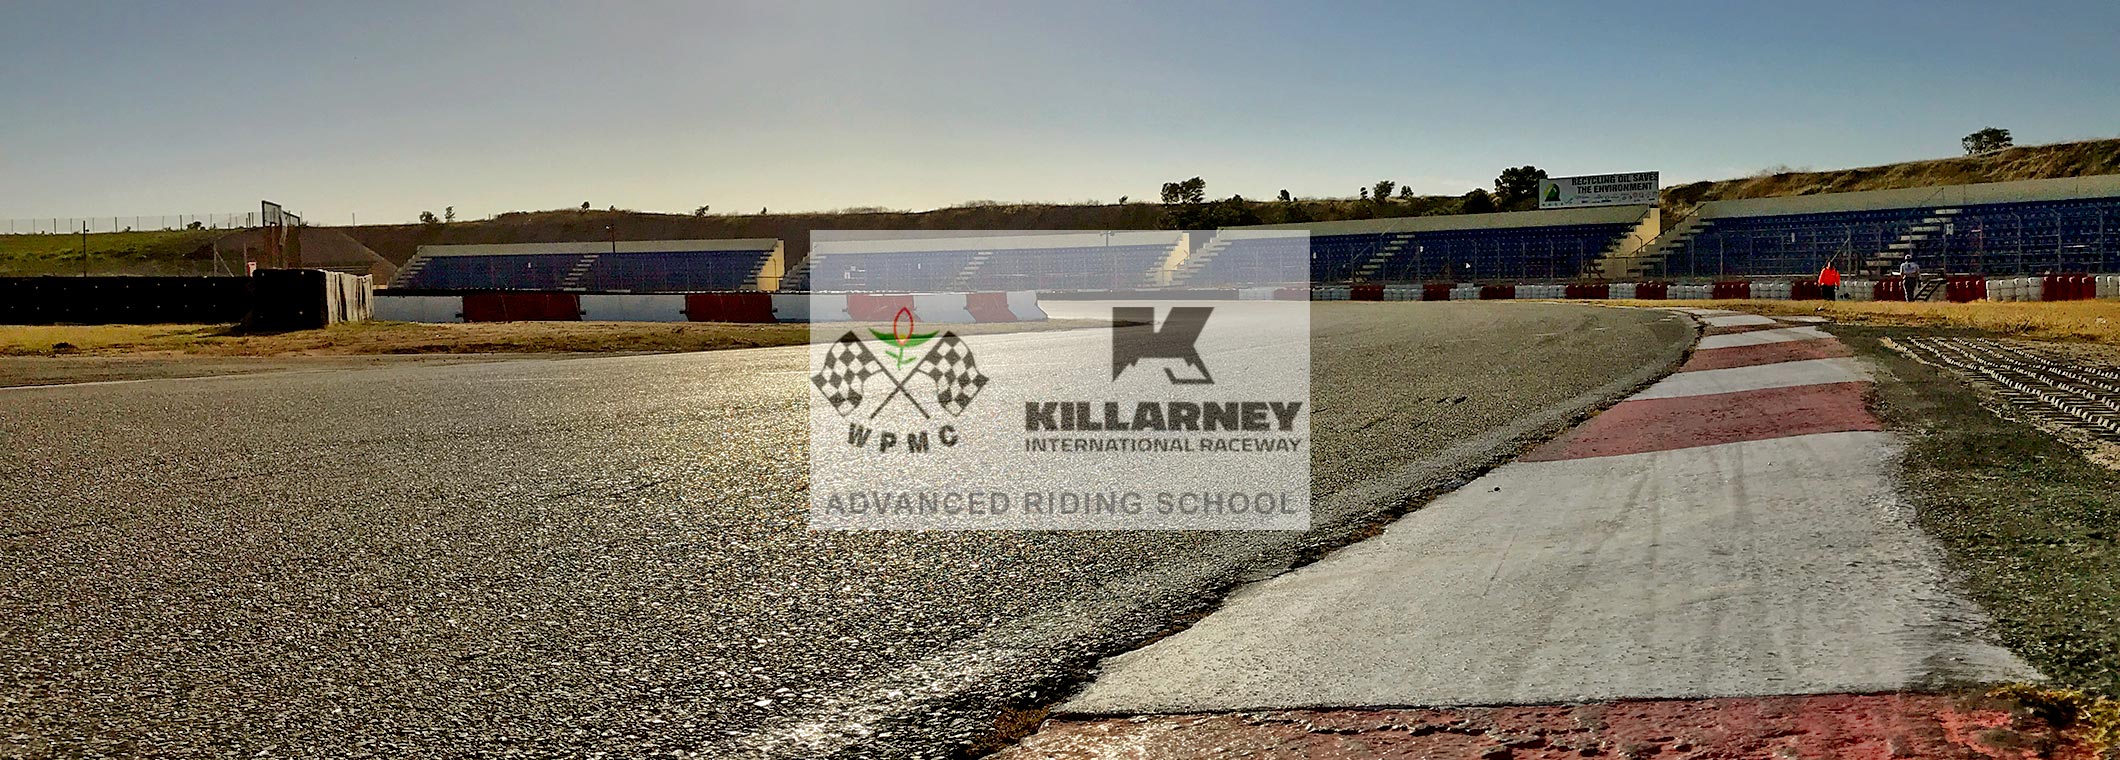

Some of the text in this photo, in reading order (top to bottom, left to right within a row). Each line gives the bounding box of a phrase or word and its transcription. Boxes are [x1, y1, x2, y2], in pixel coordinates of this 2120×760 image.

[1572, 173, 1657, 185] RECYCLING OIL SAVES
[1577, 182, 1652, 194] THE ENVIRONMENT
